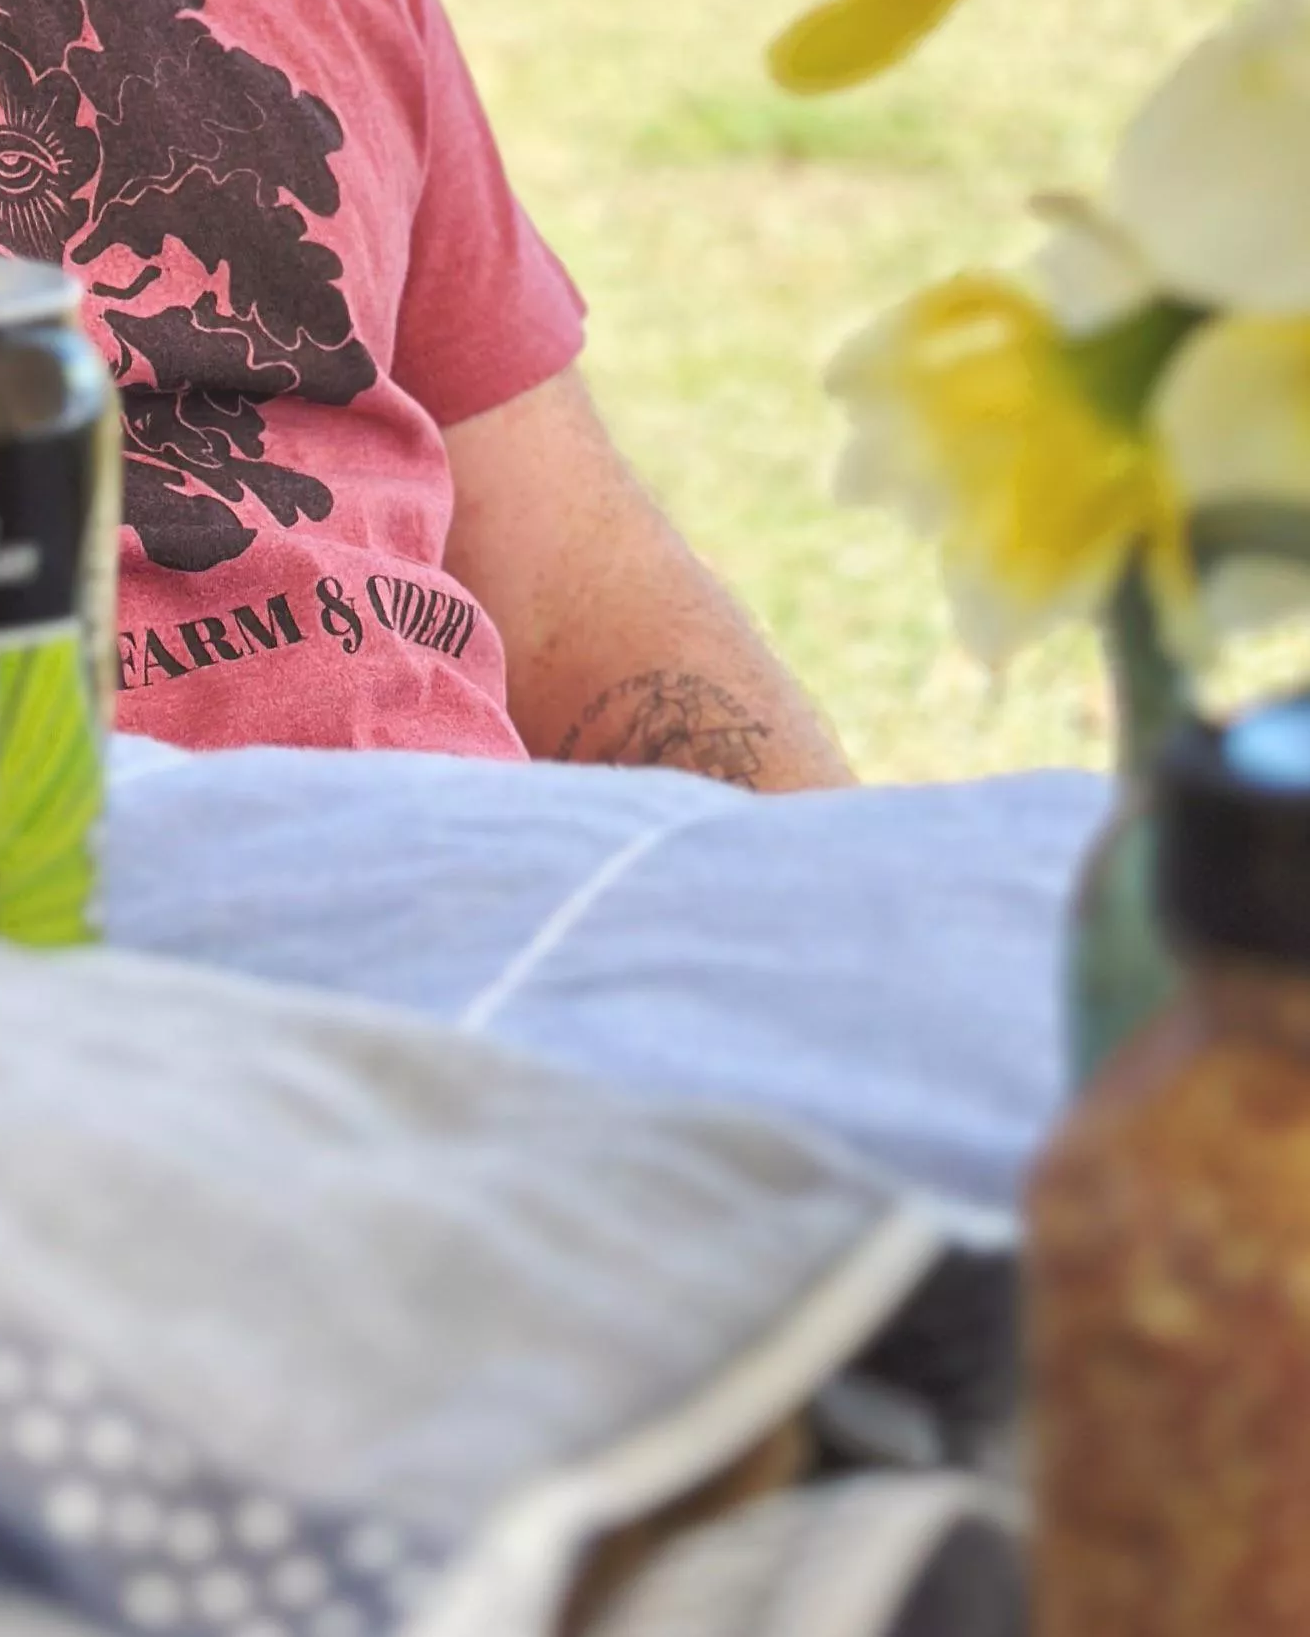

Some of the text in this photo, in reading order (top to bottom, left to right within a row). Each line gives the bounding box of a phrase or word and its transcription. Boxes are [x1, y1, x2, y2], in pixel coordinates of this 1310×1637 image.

[116, 574, 480, 691] FARM & CIDERY
